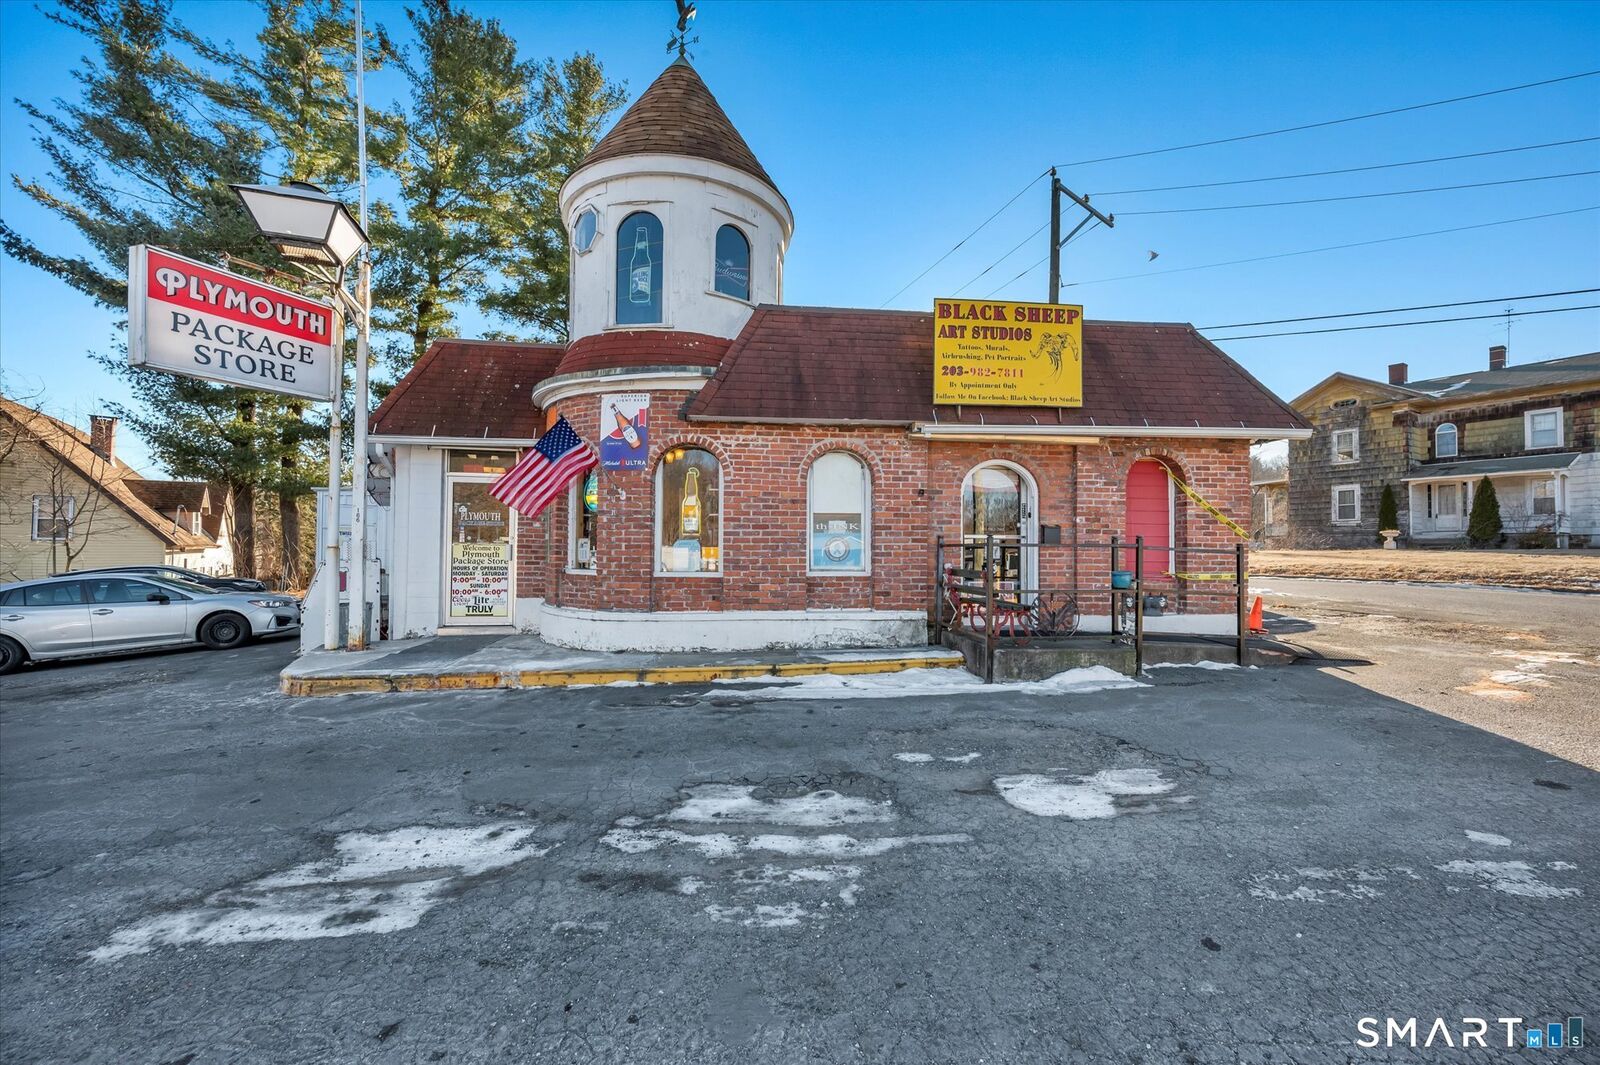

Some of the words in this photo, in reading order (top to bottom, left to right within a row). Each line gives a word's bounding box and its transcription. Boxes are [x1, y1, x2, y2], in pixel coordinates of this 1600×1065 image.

[155, 267, 326, 336] PLYMOUTH
[938, 303, 1007, 322] BLACK
[1014, 306, 1080, 325] SHEEP
[171, 311, 314, 365] PACKAGE
[937, 324, 967, 339] ART
[971, 325, 1032, 342] STUDIOS
[194, 344, 296, 384] STORE
[949, 381, 957, 389] By
[960, 382, 1001, 390] Appointment
[1003, 382, 1017, 391] Only
[1029, 395, 1048, 403] Sheep
[460, 511, 501, 521] PLYMOUTH
[462, 551, 500, 559] Plymouth
[453, 557, 485, 565] Package
[487, 557, 509, 565] Store
[465, 605, 493, 613] TRULY
